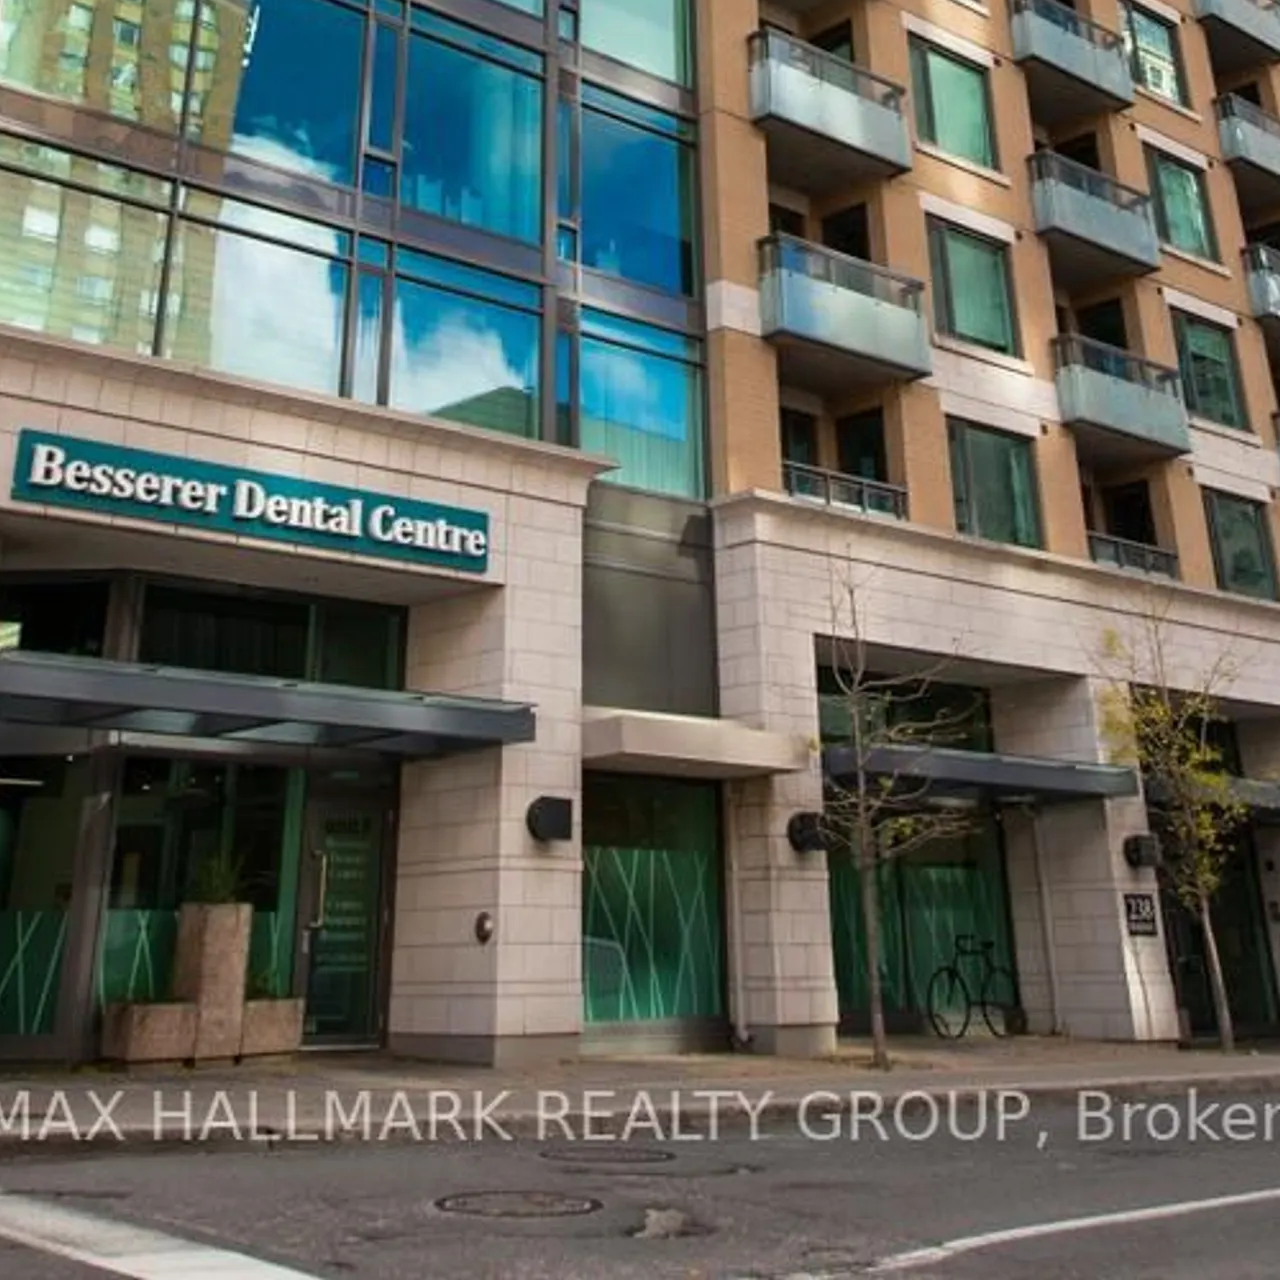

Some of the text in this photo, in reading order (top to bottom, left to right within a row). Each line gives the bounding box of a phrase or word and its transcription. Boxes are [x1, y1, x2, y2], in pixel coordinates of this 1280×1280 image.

[28, 442, 487, 557] Besserer Dental Centre
[1126, 898, 1154, 920] 238
